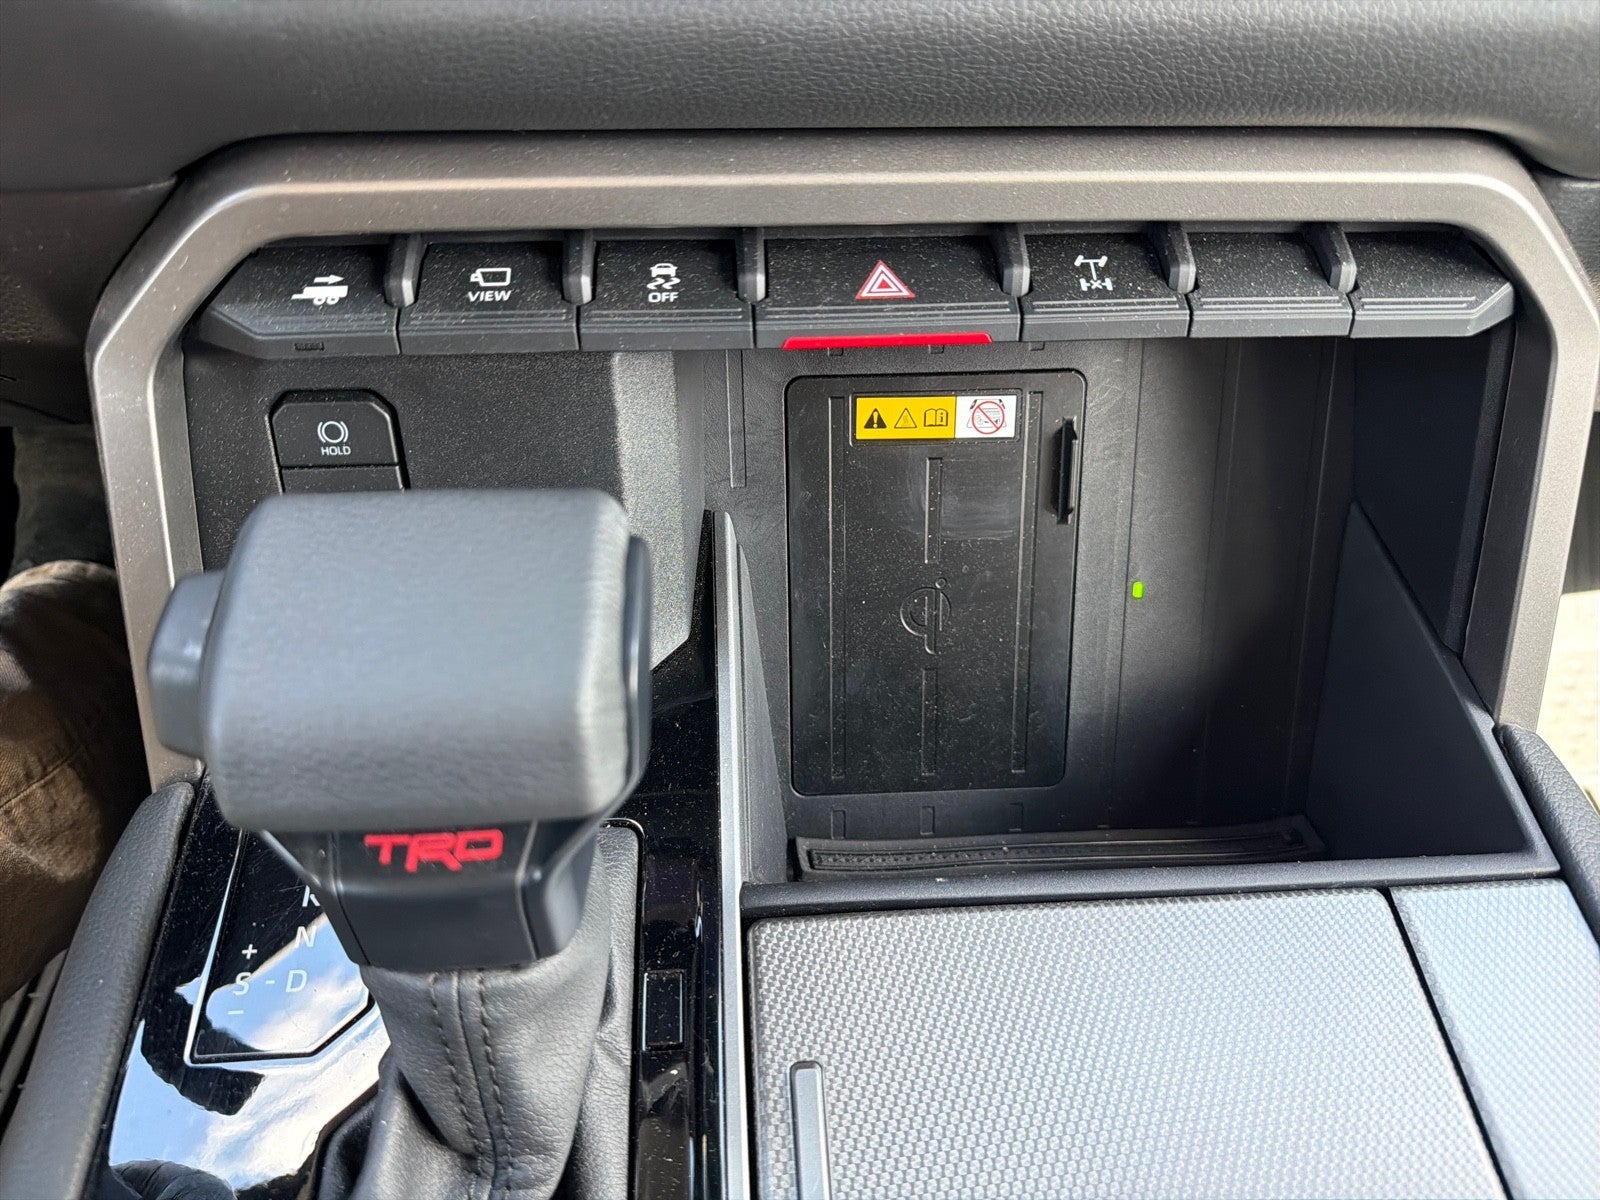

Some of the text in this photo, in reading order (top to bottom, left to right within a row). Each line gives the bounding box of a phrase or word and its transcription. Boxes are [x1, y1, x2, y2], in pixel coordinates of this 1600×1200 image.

[468, 290, 511, 301] VIEW
[648, 292, 679, 303] OFF
[320, 446, 351, 455] HOLD
[364, 829, 504, 873] TRD
[295, 926, 317, 948] N
[232, 972, 251, 995] S
[285, 969, 308, 993] D
